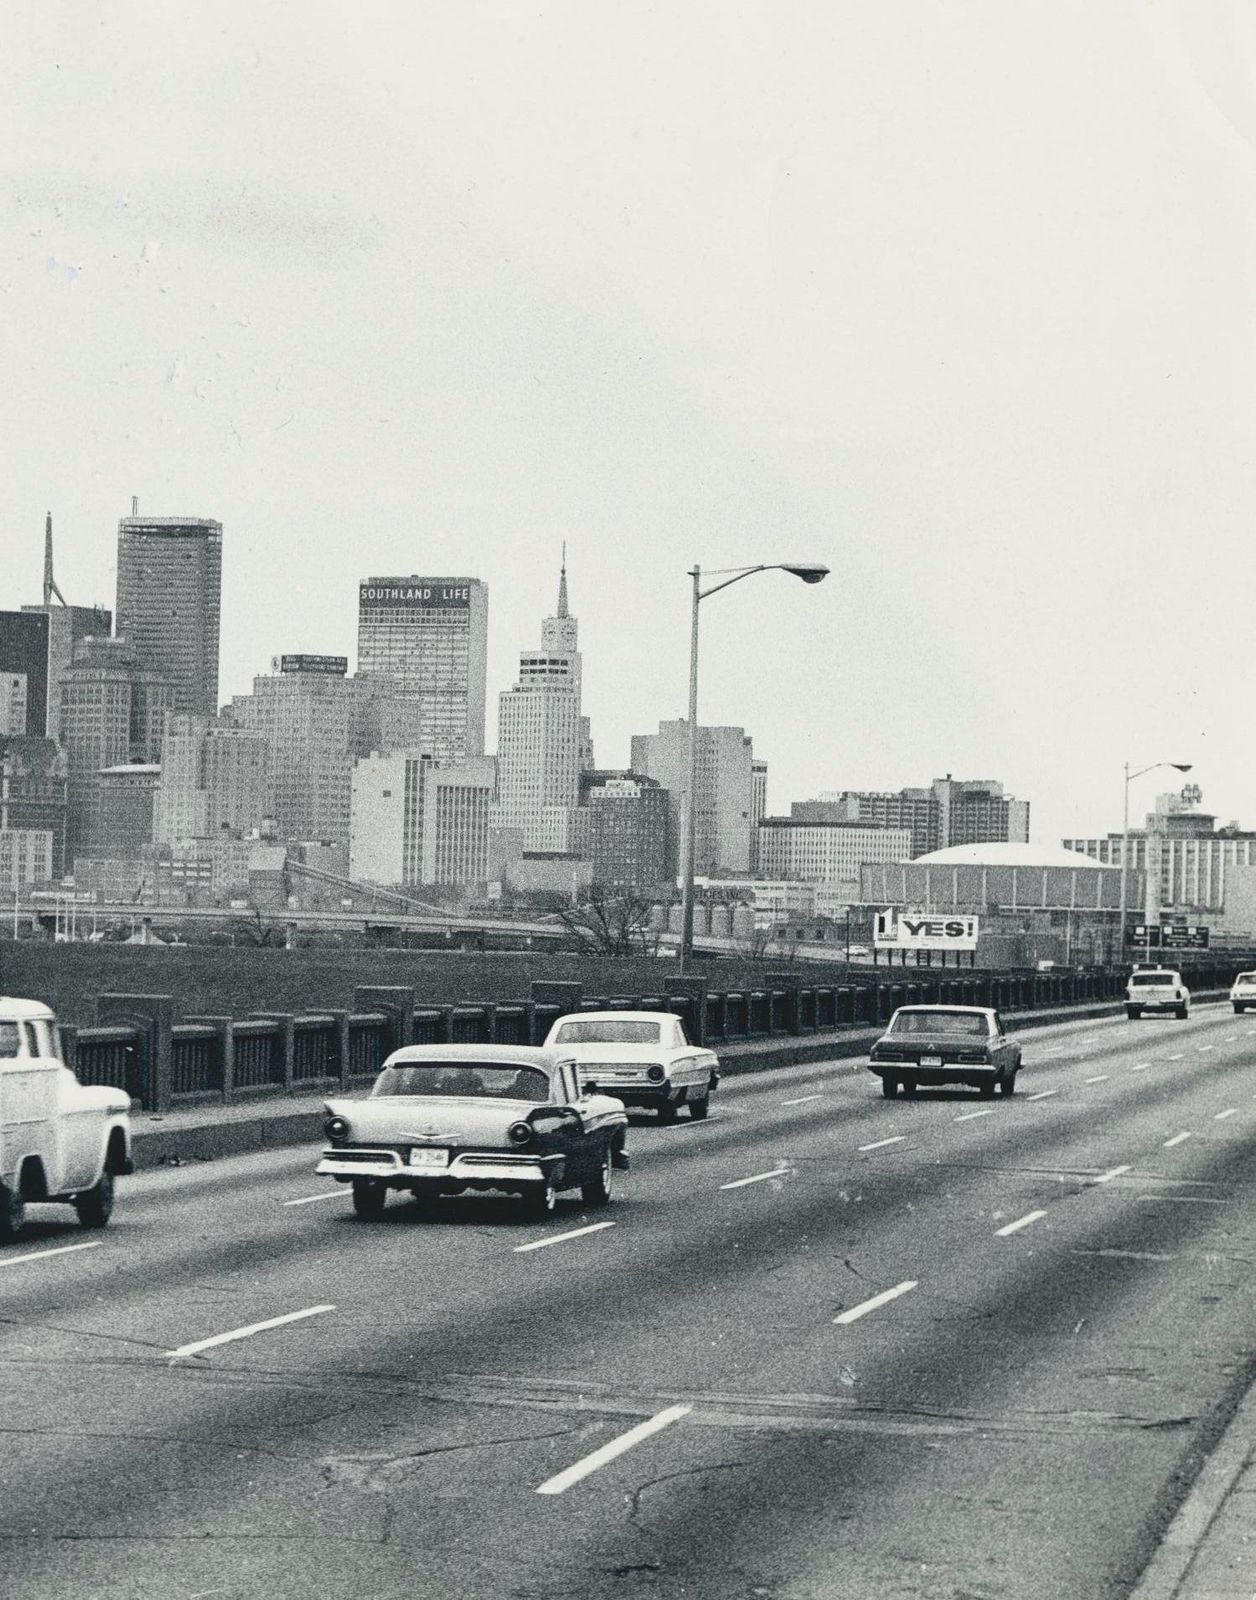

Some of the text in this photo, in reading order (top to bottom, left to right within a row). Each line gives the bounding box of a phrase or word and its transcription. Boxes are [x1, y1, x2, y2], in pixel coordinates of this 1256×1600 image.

[361, 588, 469, 600] SOUTHLAND LIFE
[902, 921, 974, 938] YES!
